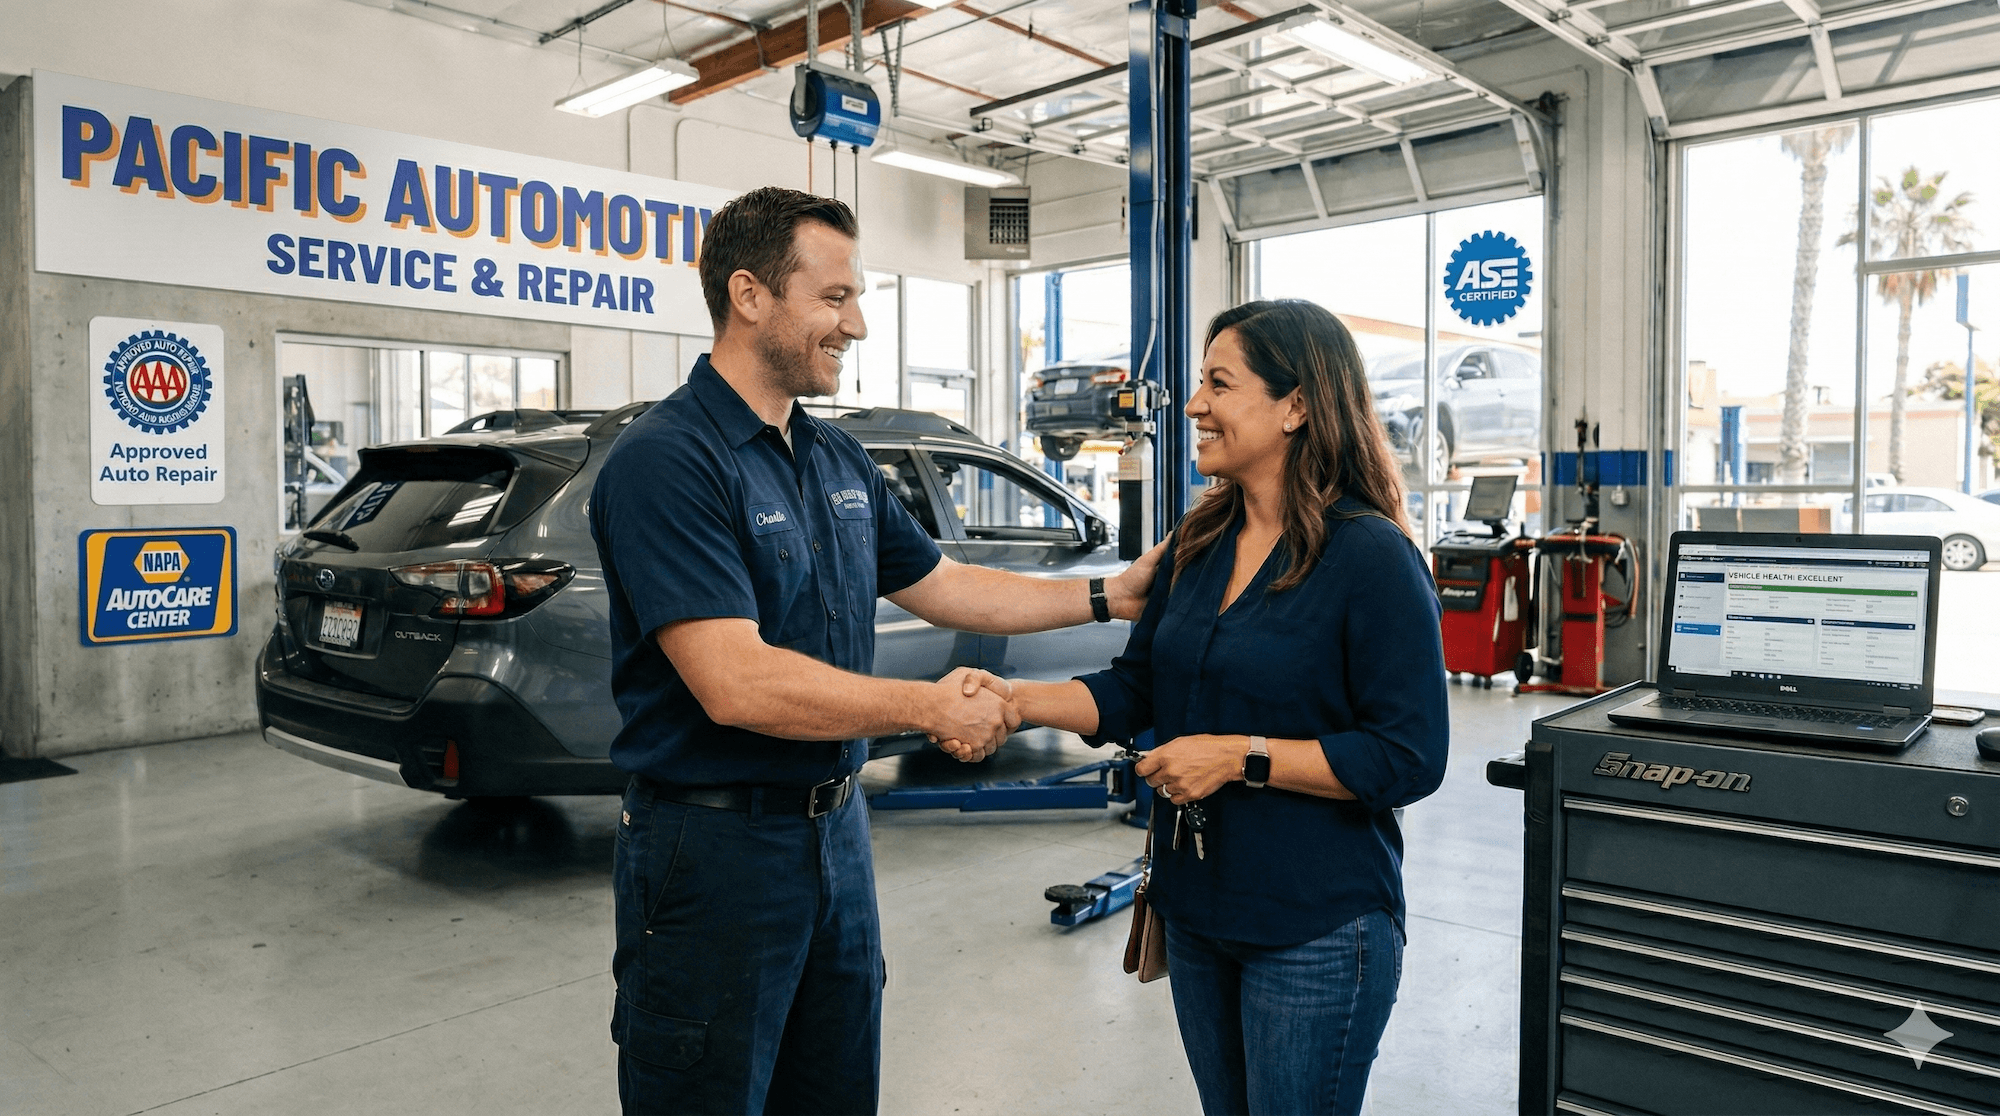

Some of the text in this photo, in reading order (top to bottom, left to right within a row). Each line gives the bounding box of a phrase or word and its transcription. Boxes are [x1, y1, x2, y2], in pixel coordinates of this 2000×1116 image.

[62, 104, 714, 268] PACIFIC AUTOMOTI
[266, 233, 655, 314] SERVICE & REPAIR
[1454, 257, 1519, 290] ASE
[1459, 289, 1518, 302] CERTIFIED
[153, 340, 177, 353] AUTO
[129, 360, 187, 401] AAA
[110, 443, 207, 464] Approved
[99, 466, 217, 486] Auto Repair
[756, 510, 787, 526] Charlie
[143, 552, 181, 572] NAPA
[1797, 574, 1844, 583] EXCELLENT
[126, 609, 190, 629] CENTER
[1593, 751, 1751, 792] Snap-on
